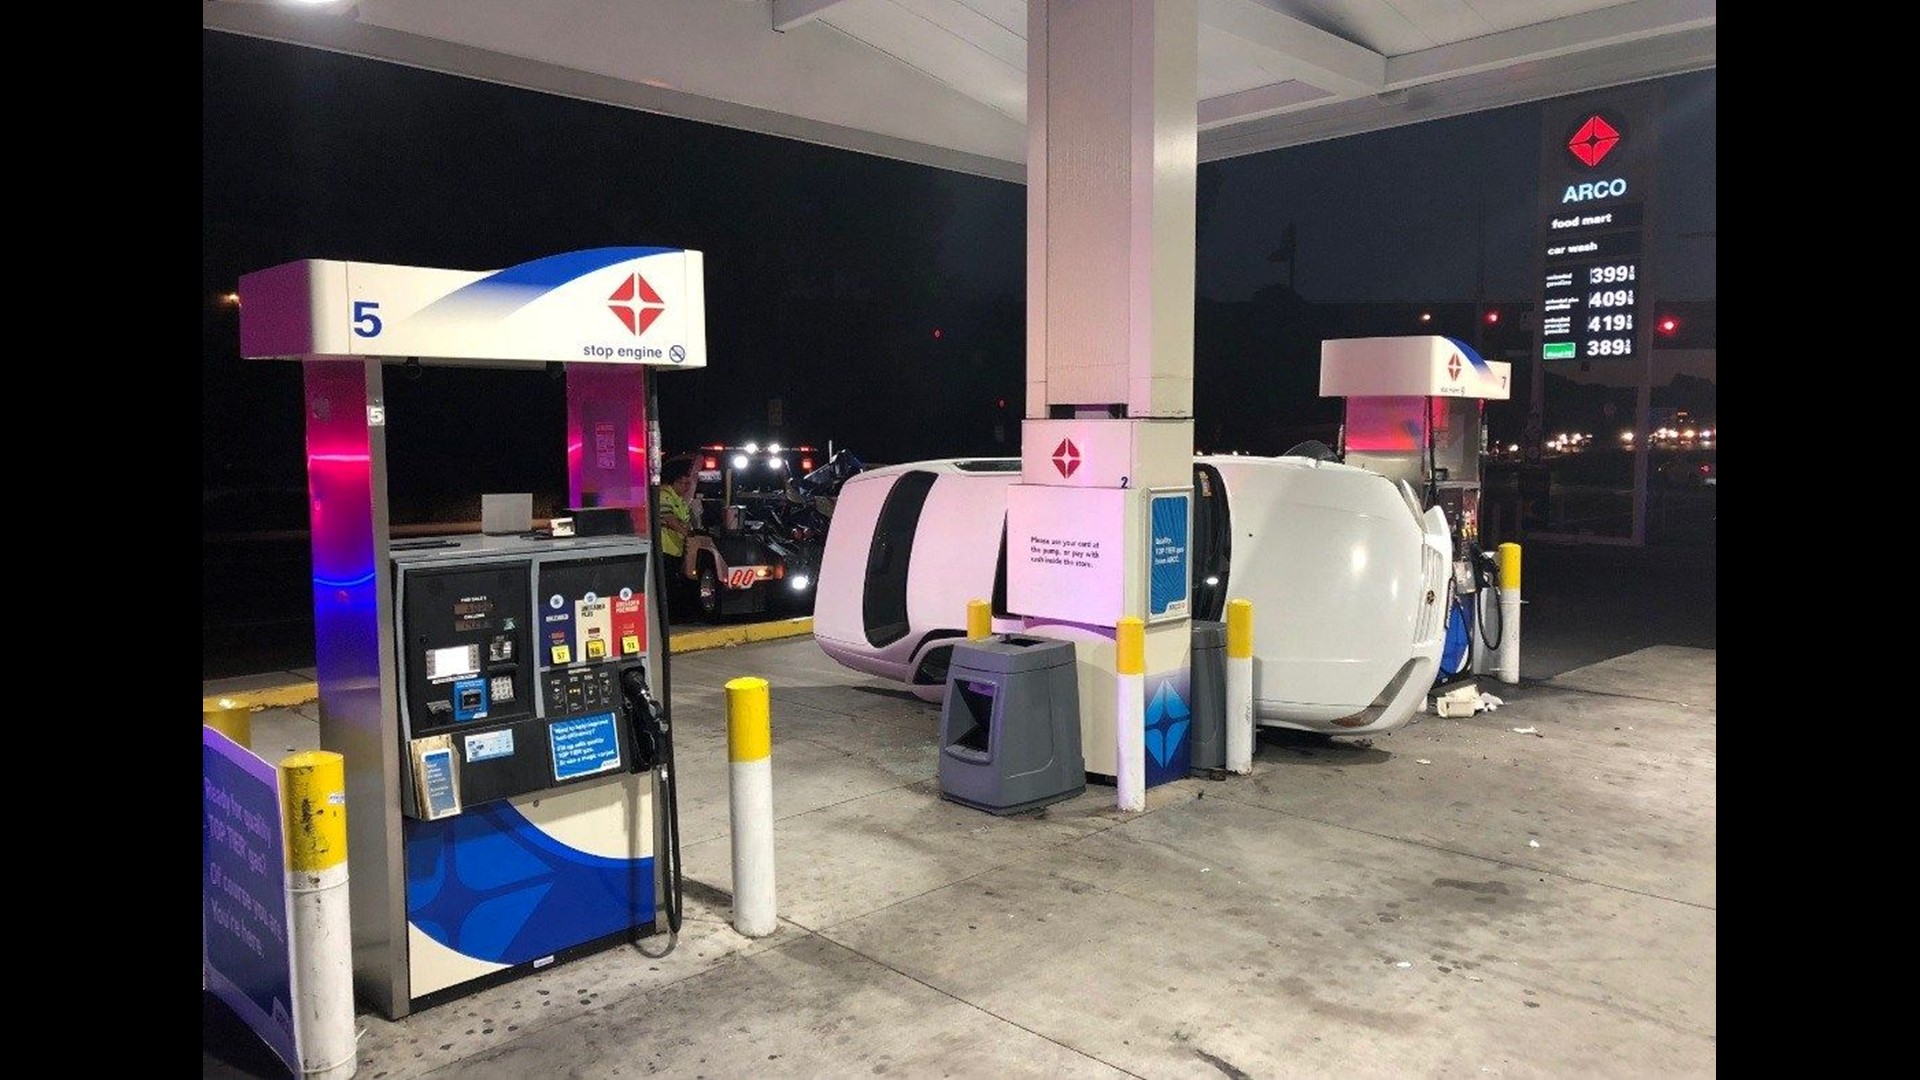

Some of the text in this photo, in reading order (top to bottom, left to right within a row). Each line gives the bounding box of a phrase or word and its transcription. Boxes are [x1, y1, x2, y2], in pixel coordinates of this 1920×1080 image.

[1562, 178, 1627, 204] ARCO
[1551, 213, 1612, 229] food mart
[1547, 241, 1598, 255] car wash
[354, 301, 382, 338] 5
[583, 345, 662, 360] stop engine
[1502, 376, 1507, 389] 7
[370, 407, 383, 422] 5
[1121, 476, 1128, 489] 2
[1030, 535, 1049, 545] Please
[1062, 540, 1076, 548] your
[1072, 550, 1084, 558] pay
[1044, 556, 1062, 565] inside
[1075, 560, 1094, 568] store.
